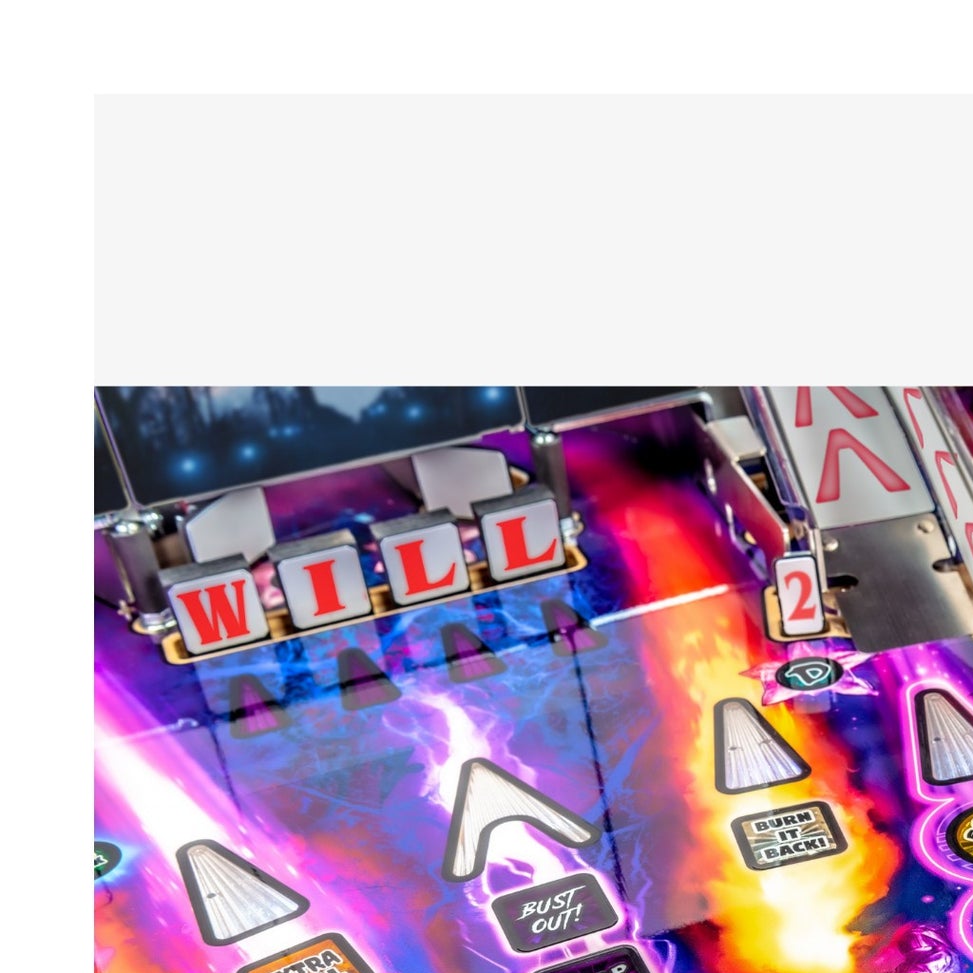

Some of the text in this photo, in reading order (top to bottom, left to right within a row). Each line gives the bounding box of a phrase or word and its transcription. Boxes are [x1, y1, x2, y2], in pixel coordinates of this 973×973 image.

[176, 515, 560, 647] WILL
[783, 570, 816, 622] 2
[784, 660, 832, 687] D
[754, 811, 813, 833] BURN
[777, 828, 800, 842] IT
[763, 837, 828, 860] BACK!
[516, 884, 587, 921] BUST
[531, 903, 583, 934] OUT!
